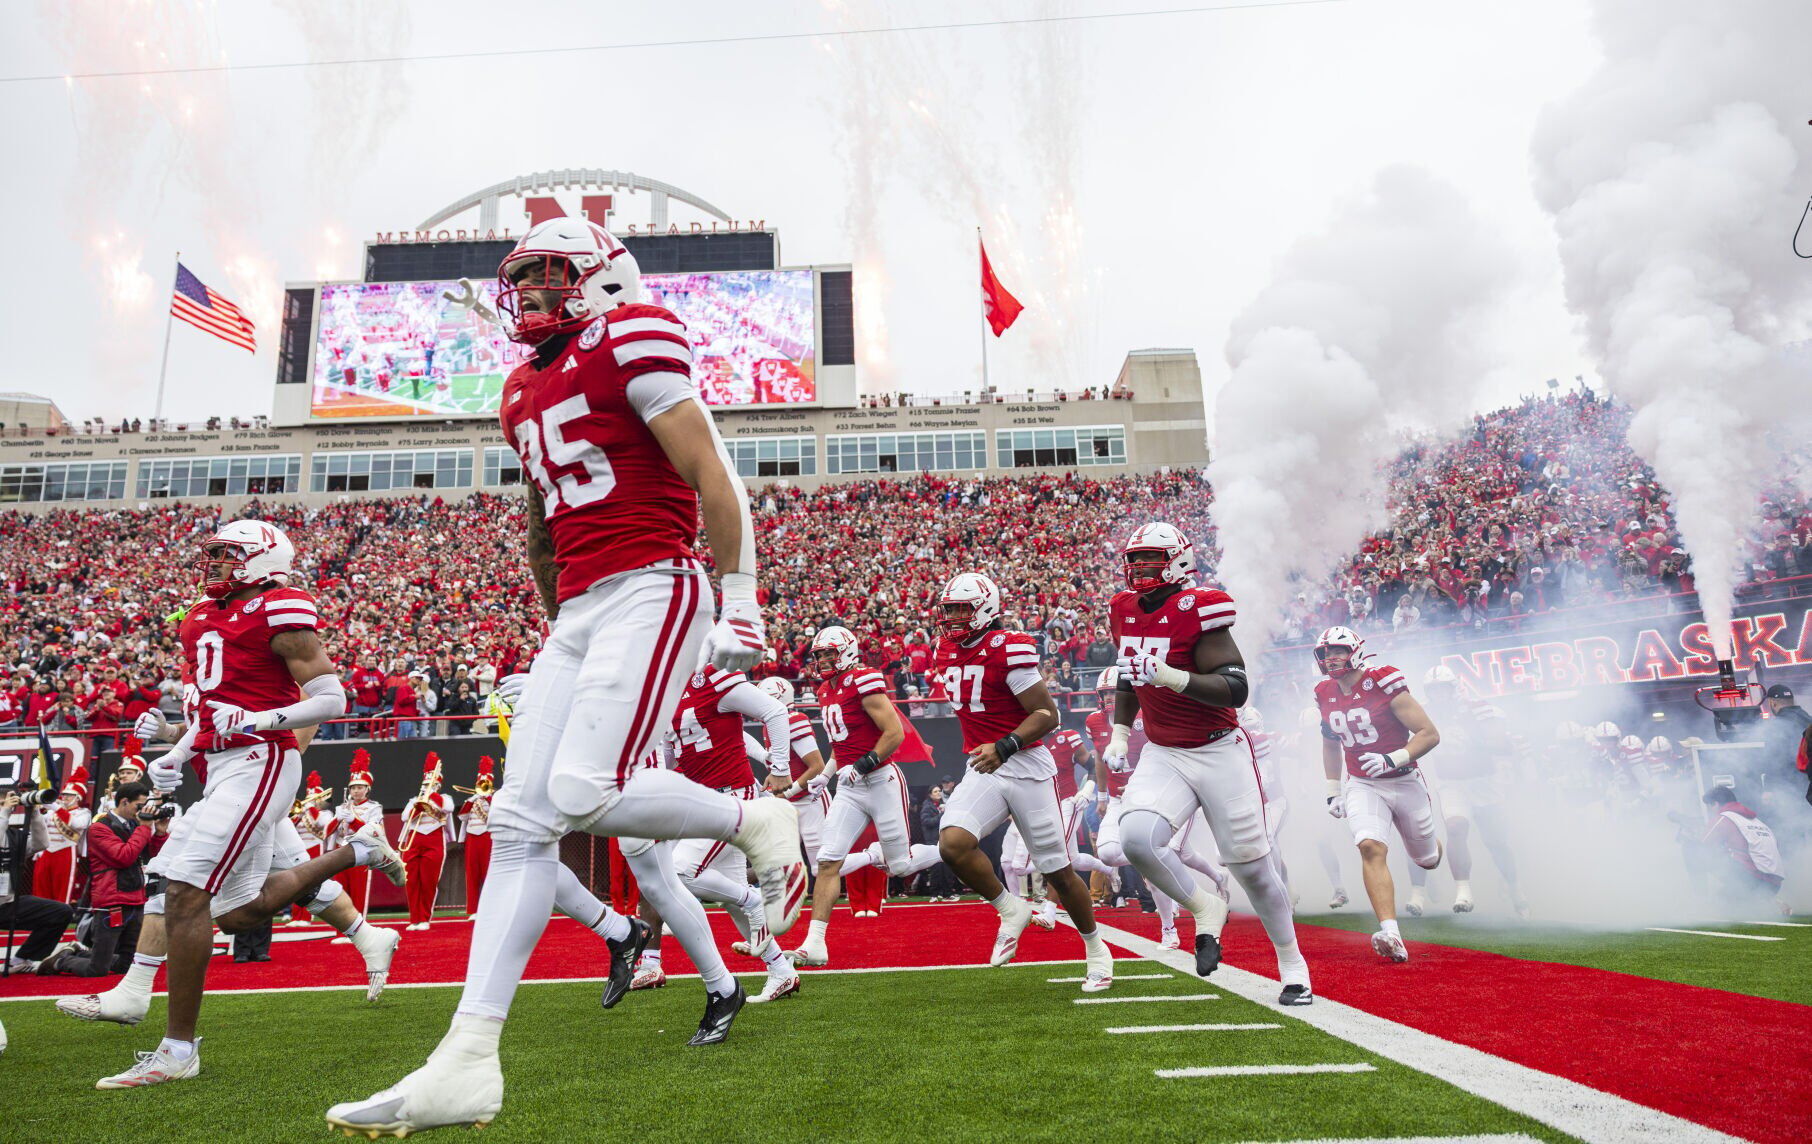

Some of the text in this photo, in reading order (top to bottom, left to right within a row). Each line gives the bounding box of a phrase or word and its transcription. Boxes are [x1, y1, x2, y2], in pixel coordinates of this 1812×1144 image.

[376, 219, 767, 245] MEMORIAL STADIUM
[261, 526, 275, 546] N
[196, 630, 224, 691] 0
[944, 665, 986, 712] 97
[674, 706, 713, 758] 4
[1328, 707, 1379, 748] 93
